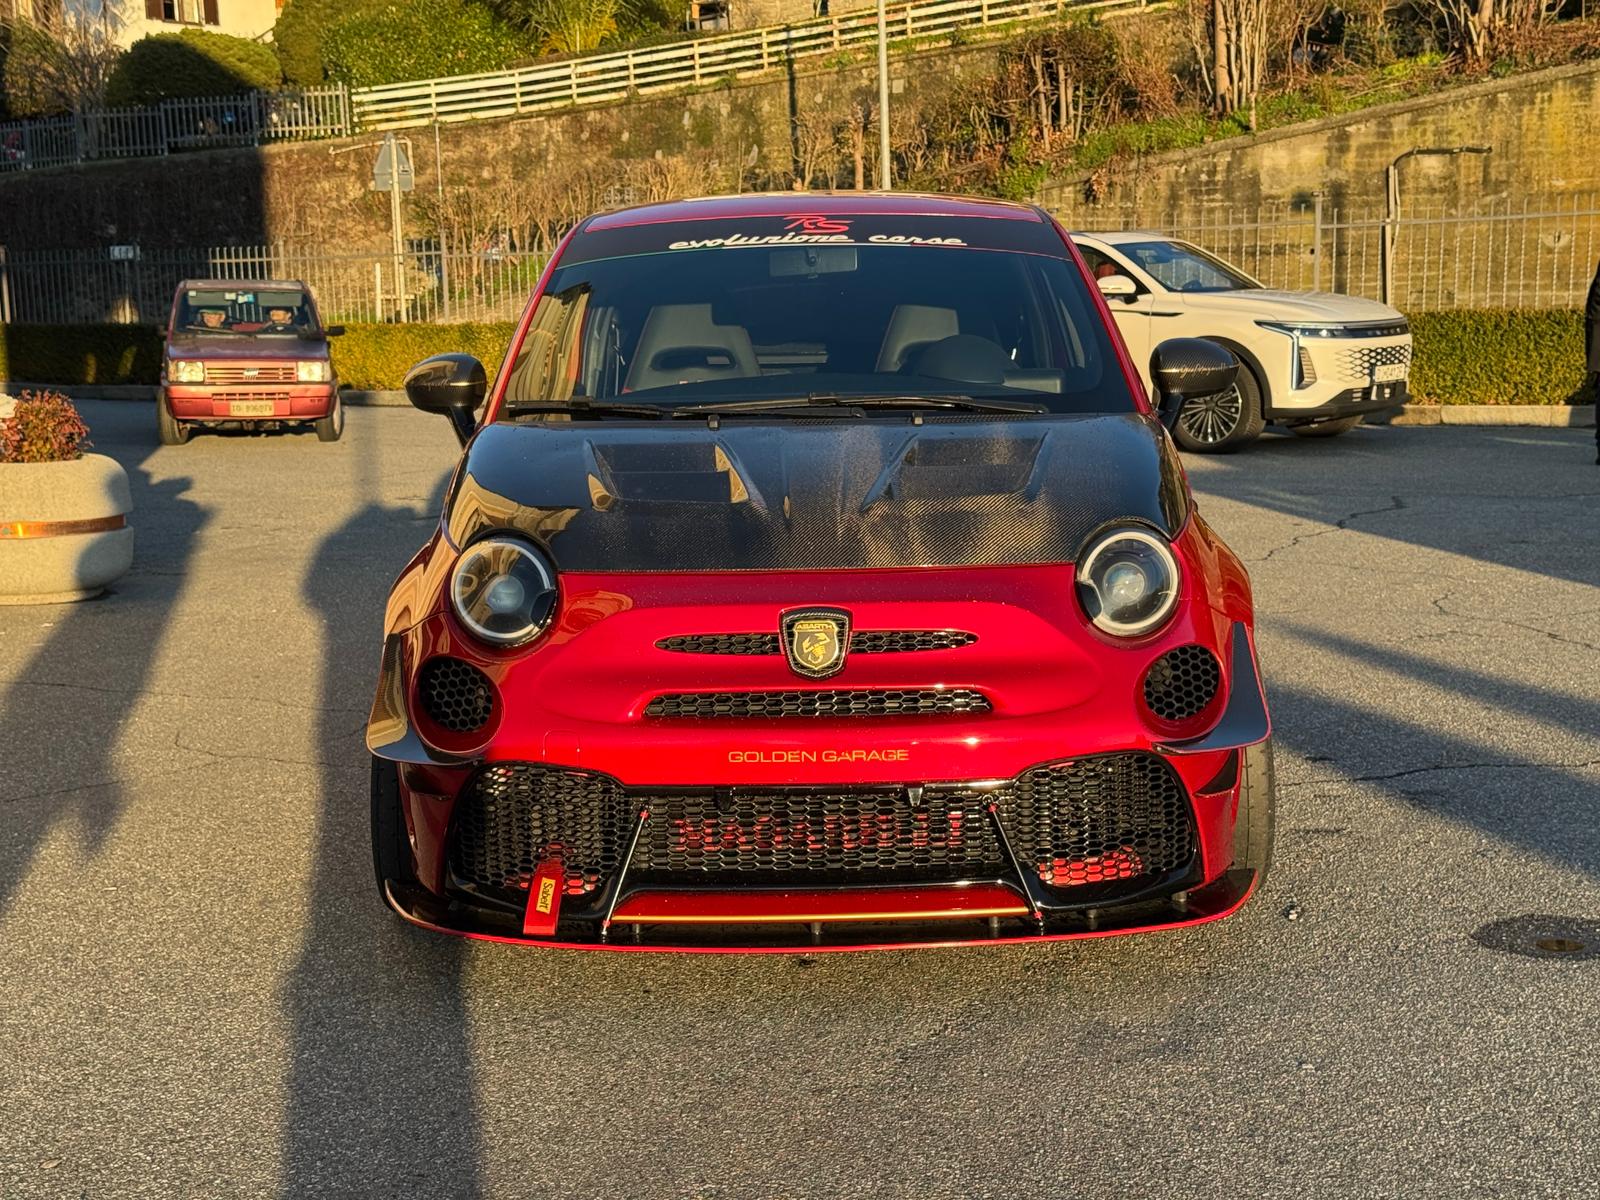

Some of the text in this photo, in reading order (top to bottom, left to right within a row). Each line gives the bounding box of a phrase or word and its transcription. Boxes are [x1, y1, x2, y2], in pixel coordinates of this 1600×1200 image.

[783, 215, 854, 233] RS
[668, 231, 855, 250] evoluzione
[728, 749, 910, 763] GOLDEN GARAGE
[539, 882, 553, 909] Sabelt
